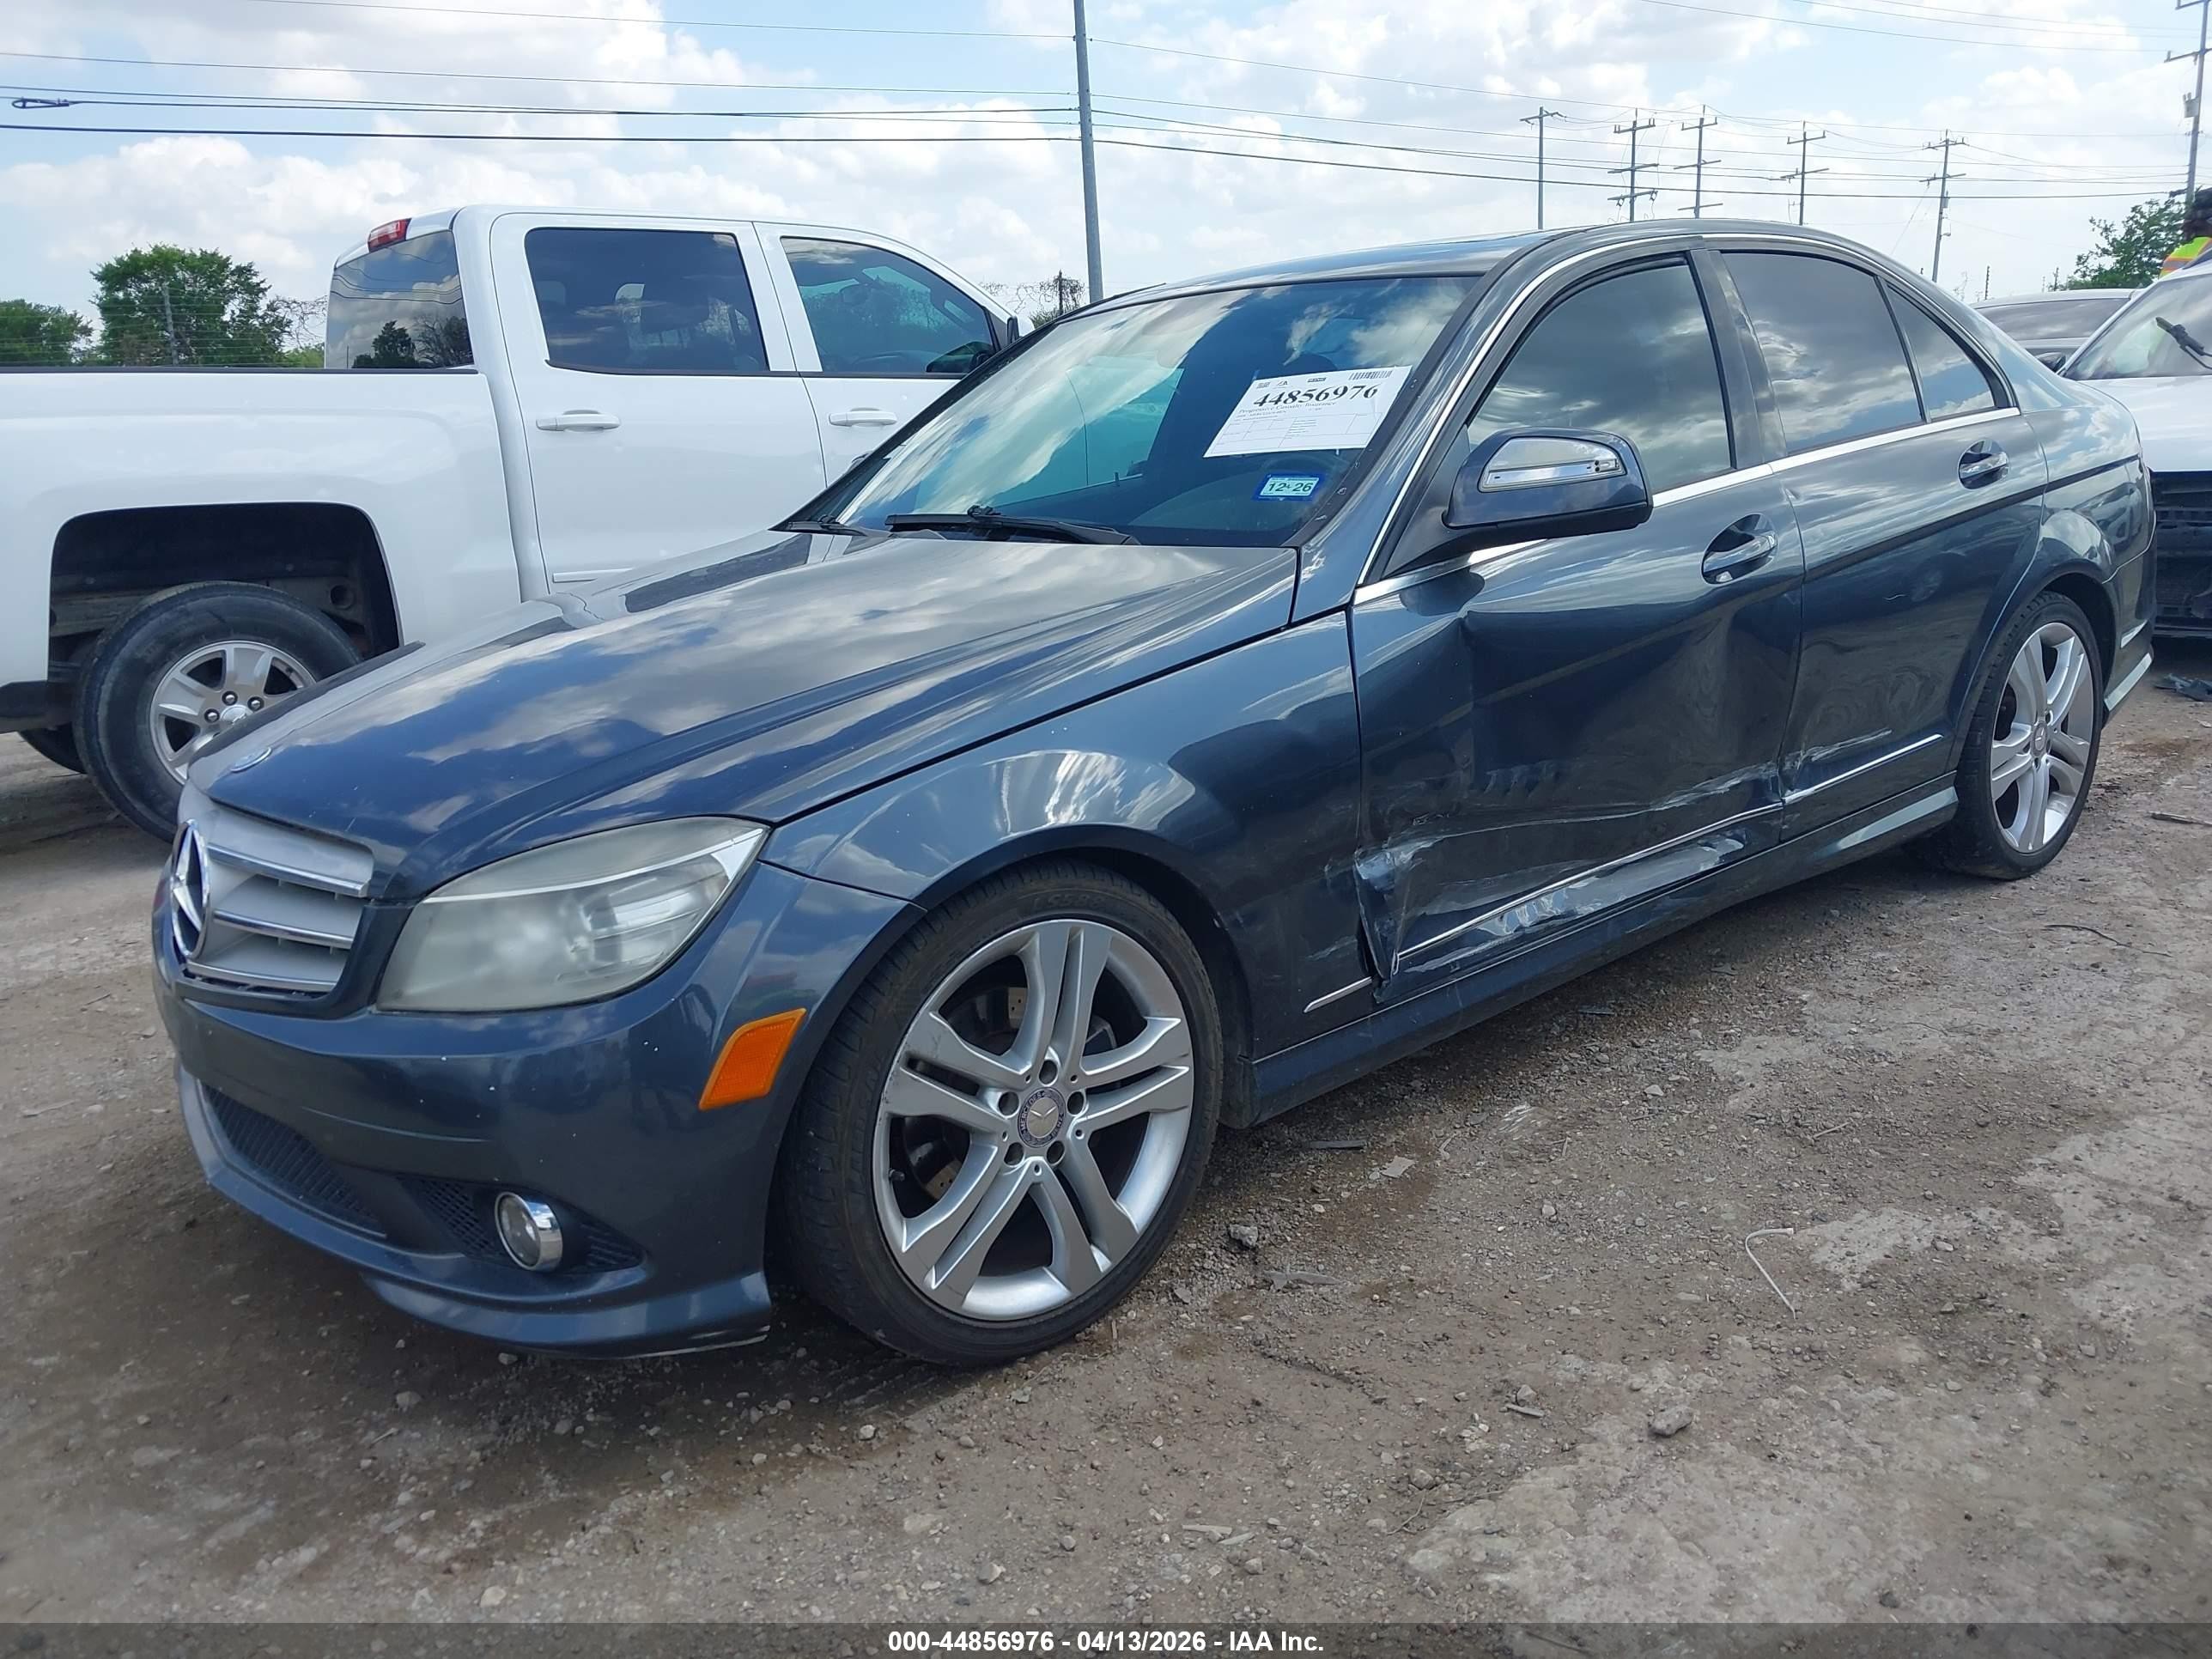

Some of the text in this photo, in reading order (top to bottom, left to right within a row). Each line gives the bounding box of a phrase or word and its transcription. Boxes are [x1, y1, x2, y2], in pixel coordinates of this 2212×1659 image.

[1254, 384, 1380, 406] 44856976
[1268, 483, 1313, 492] 12 26
[1020, 1091, 1046, 1132] MERCEDES
